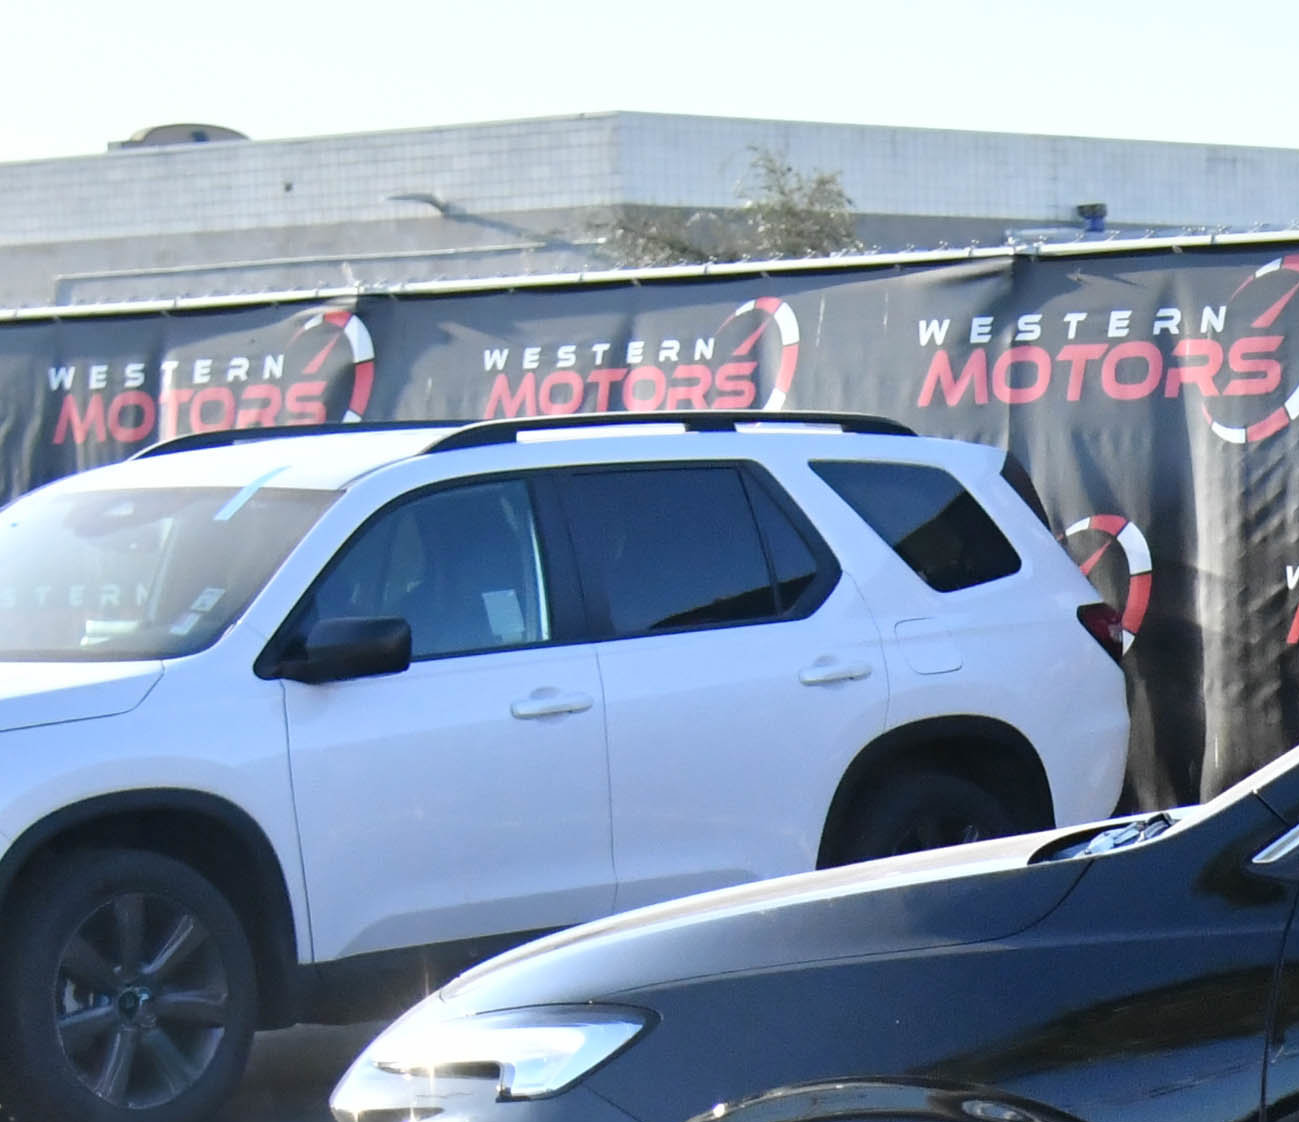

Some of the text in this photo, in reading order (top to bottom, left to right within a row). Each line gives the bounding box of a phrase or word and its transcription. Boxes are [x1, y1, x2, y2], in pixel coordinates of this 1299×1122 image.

[918, 304, 1229, 347] WESTERN
[48, 353, 285, 392] WESTERN
[482, 337, 715, 371] WESTERN
[917, 334, 1284, 408] MOTORS
[53, 380, 328, 445] MOTORS
[483, 360, 758, 420] MOTORS
